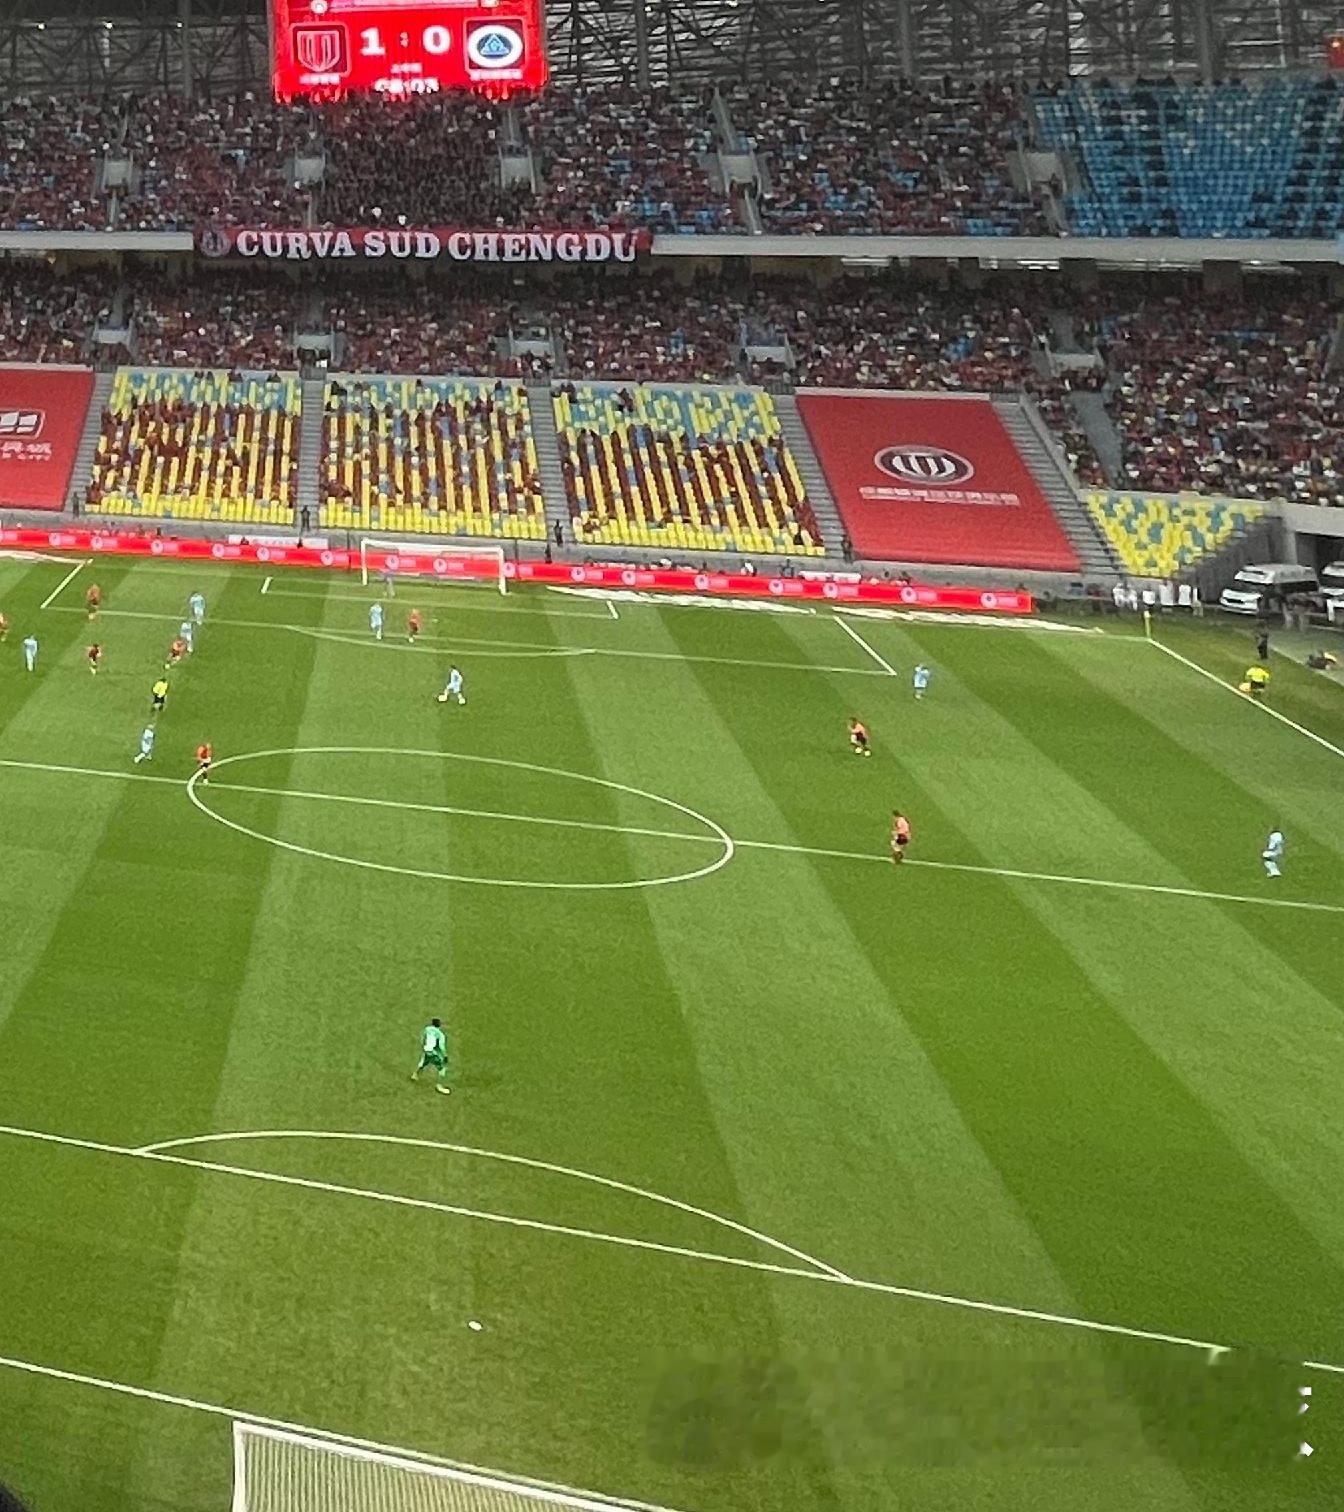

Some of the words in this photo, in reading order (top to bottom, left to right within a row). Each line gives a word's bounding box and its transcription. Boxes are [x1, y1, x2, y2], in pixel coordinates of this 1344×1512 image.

[360, 27, 386, 56] 1
[422, 25, 451, 55] 0
[236, 230, 356, 259] CURVA
[364, 231, 441, 259] SUD
[447, 231, 638, 263] CHENGDU
